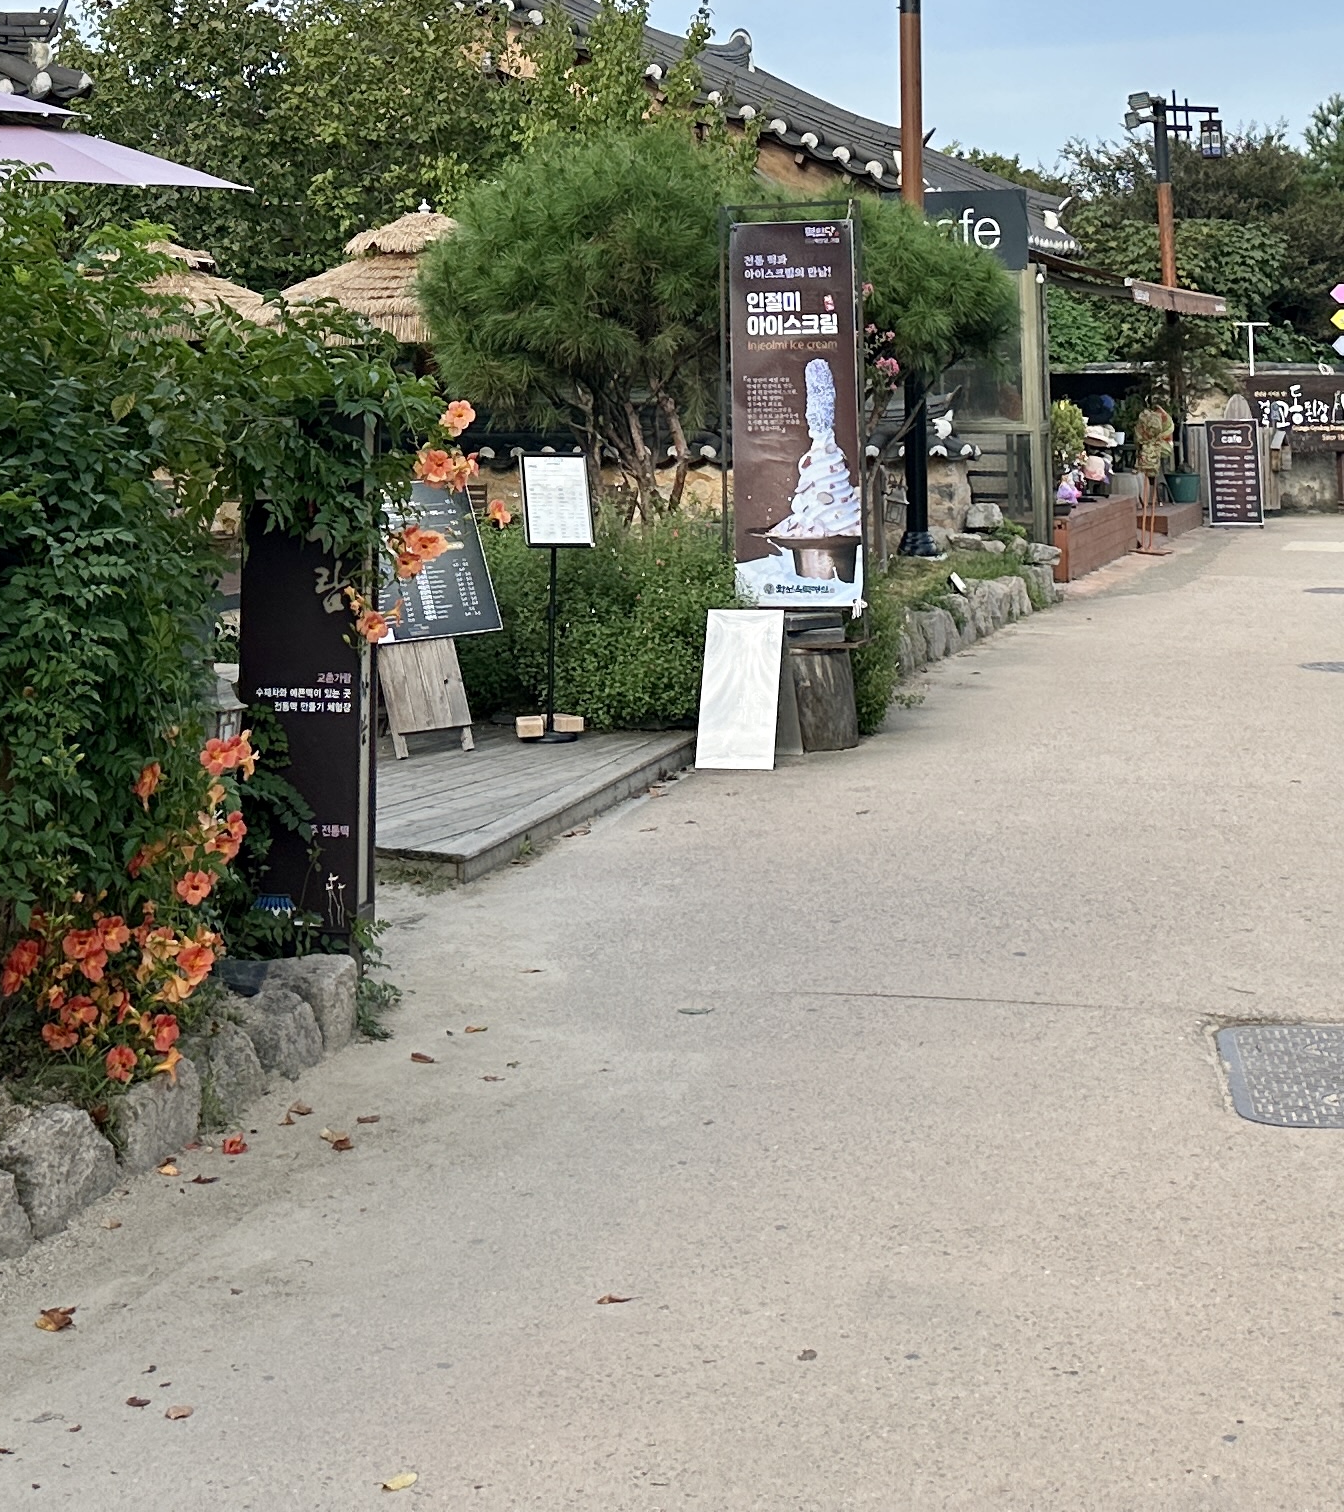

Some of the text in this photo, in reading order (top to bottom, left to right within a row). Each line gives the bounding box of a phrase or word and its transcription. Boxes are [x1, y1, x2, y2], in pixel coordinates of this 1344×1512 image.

[744, 267, 804, 279] 아이스크림의
[746, 291, 801, 313] 인절미
[747, 313, 838, 335] 아이스크림
[747, 340, 837, 352] Injeolmi Ice cream
[324, 688, 340, 698] 있는
[343, 688, 352, 699] 곳
[300, 701, 324, 712] 만들기
[327, 701, 352, 713] 체험장
[322, 824, 349, 838] 전통떡
